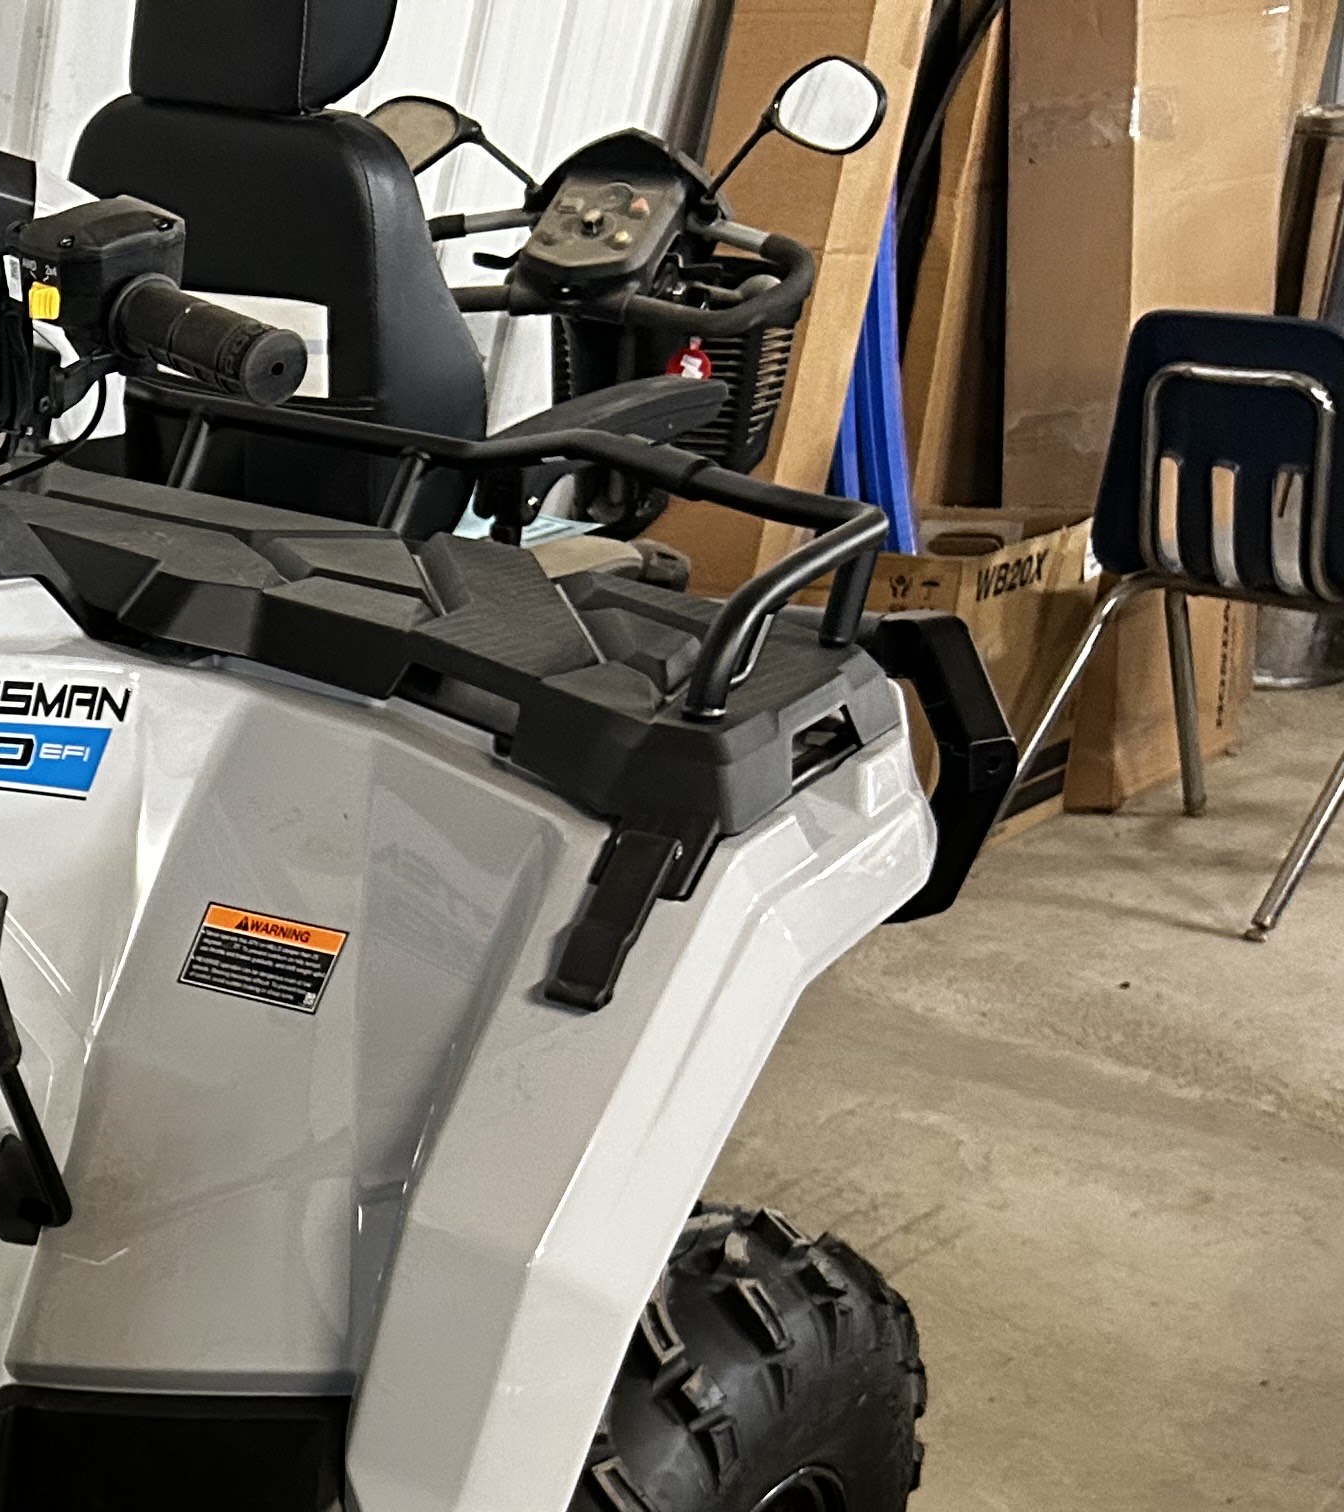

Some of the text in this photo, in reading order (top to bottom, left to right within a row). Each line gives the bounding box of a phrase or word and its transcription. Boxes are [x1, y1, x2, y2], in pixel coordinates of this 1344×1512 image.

[976, 549, 1049, 603] WB20X
[39, 743, 91, 763] EFI
[250, 918, 312, 944] WARNING
